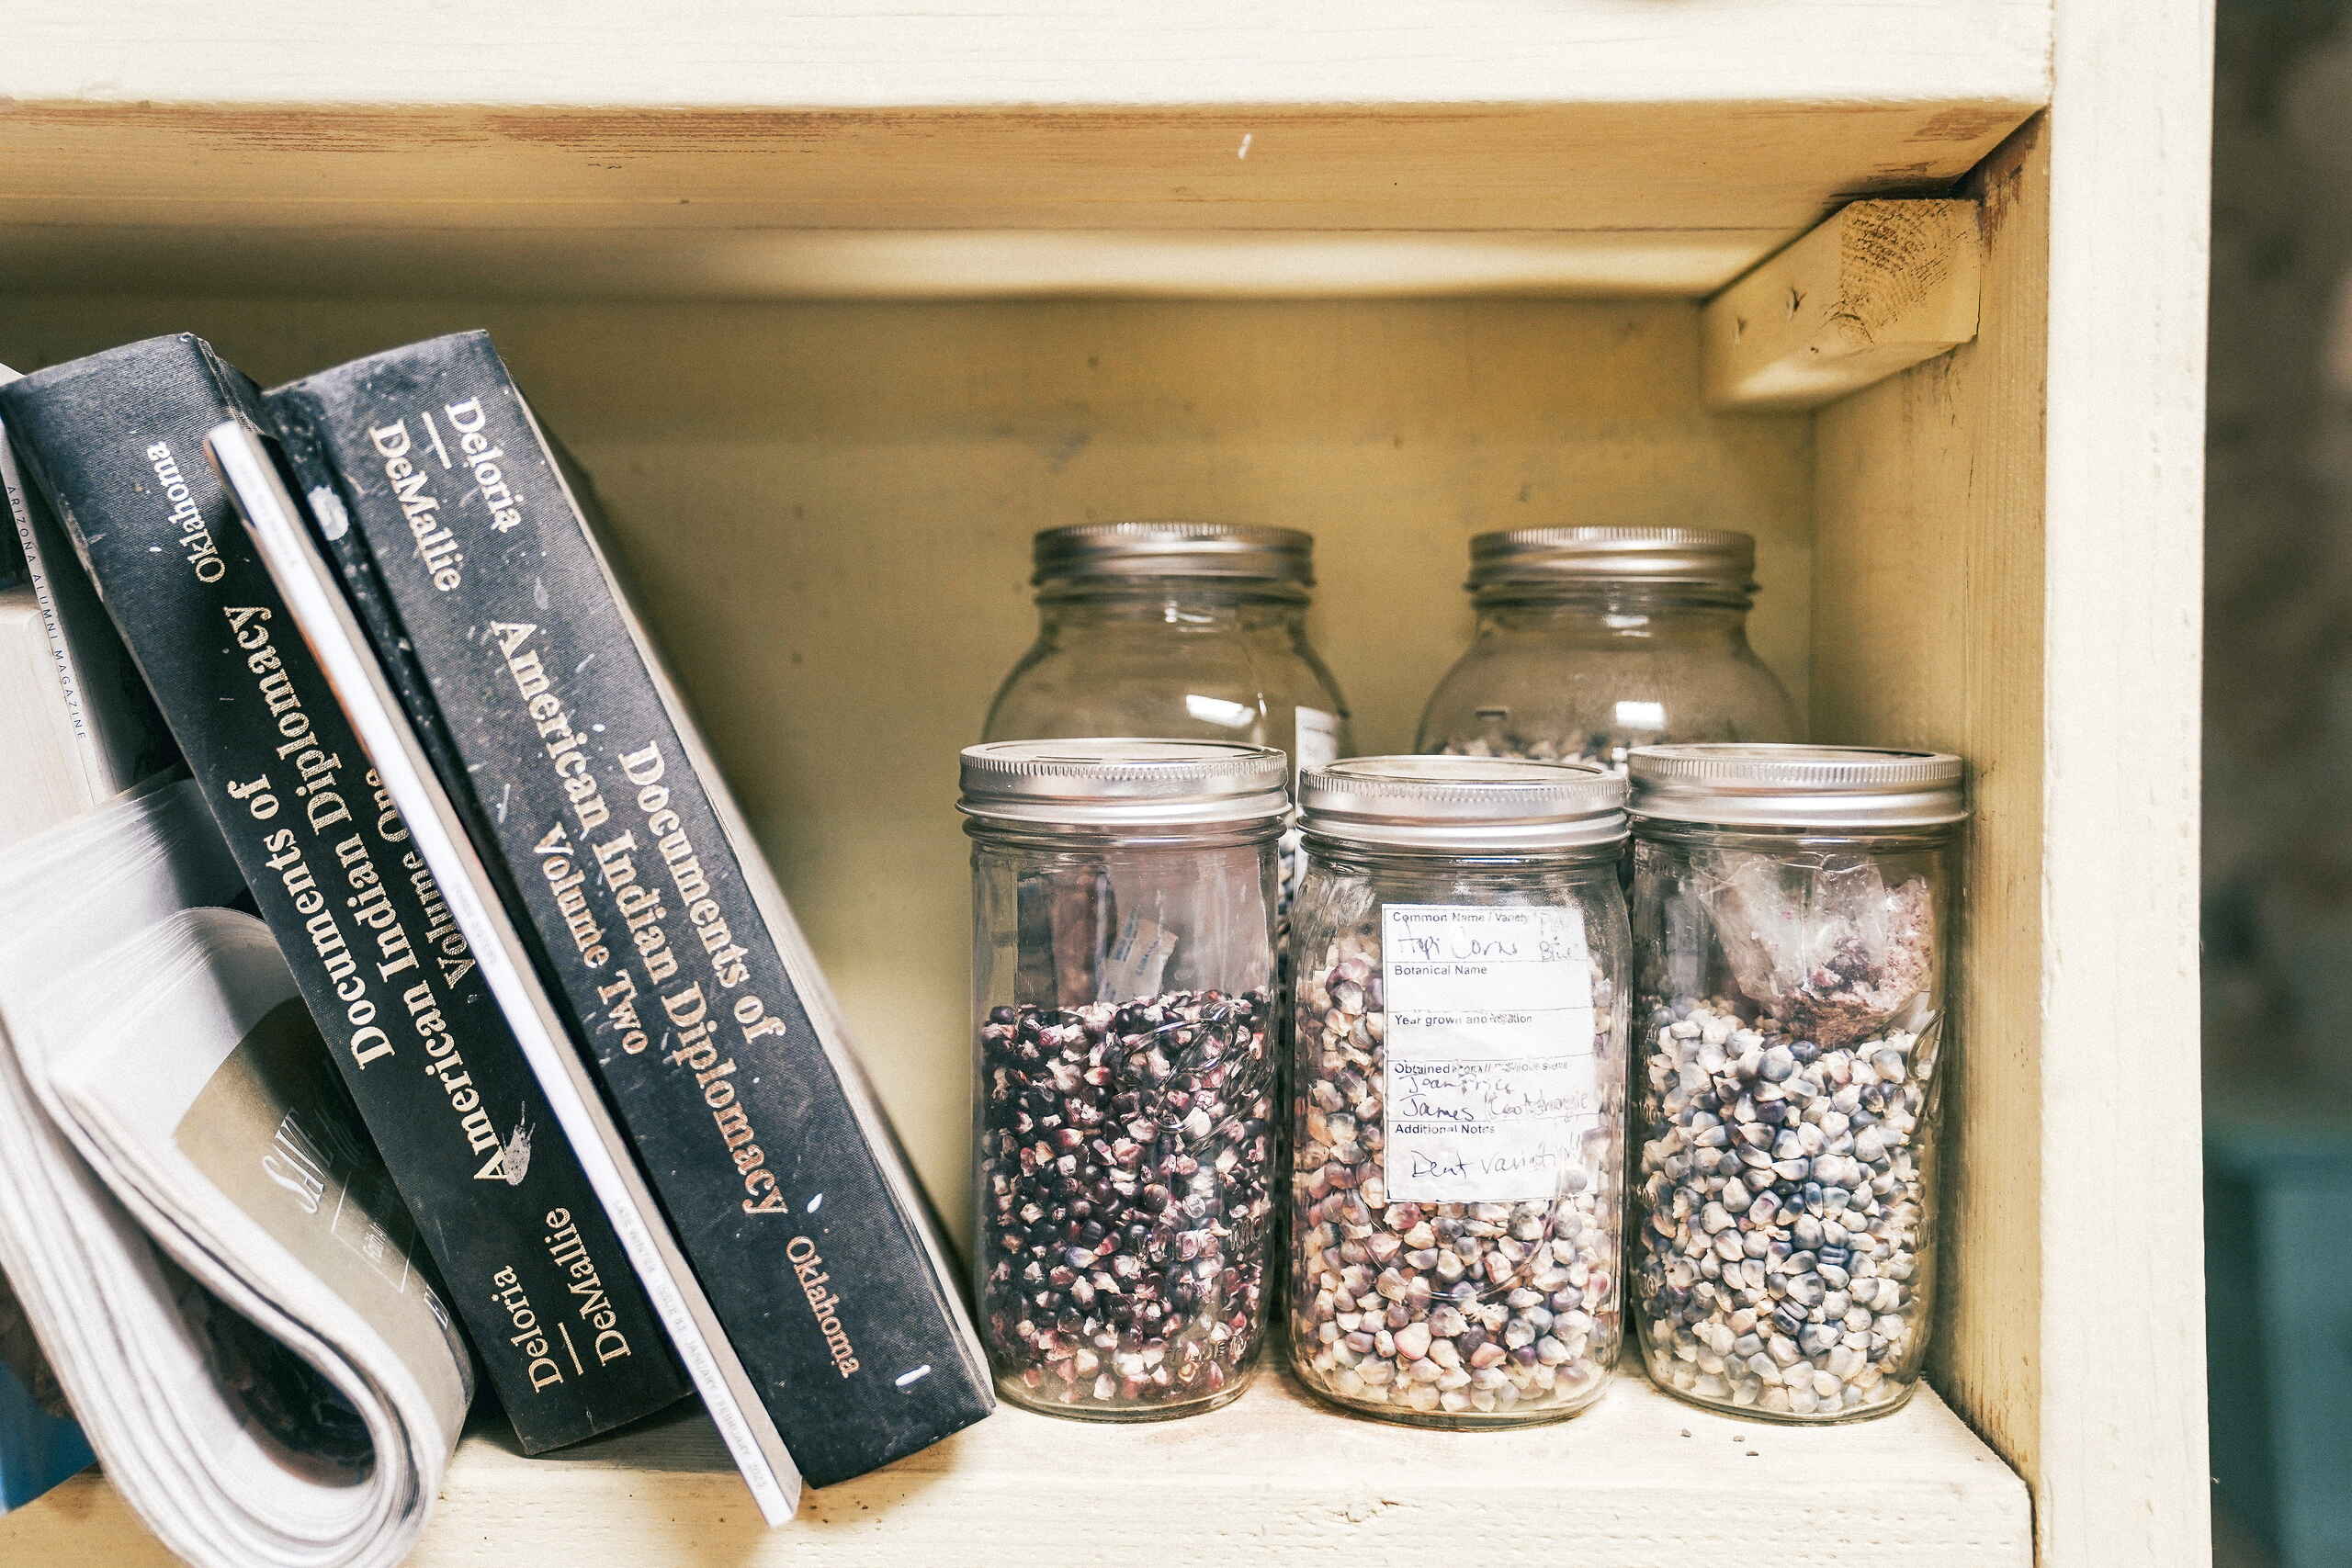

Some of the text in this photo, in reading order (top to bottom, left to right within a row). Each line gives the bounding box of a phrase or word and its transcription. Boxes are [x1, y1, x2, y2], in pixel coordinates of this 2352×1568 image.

[146, 440, 226, 584] Oklahoma
[368, 419, 461, 592] DeMallie
[445, 397, 522, 533] Deloria
[7, 484, 86, 740] ARIZONA ALUMNI MAGAZINE
[222, 605, 352, 836] Diplomacy
[366, 768, 410, 843] One
[227, 774, 396, 1070] Documents of
[335, 833, 420, 984] Indian
[402, 852, 476, 990] Volume
[490, 620, 788, 1215] American Indian Diplomacy
[534, 820, 647, 1056] Volume Two
[618, 740, 785, 1044] Documents of
[1393, 911, 1448, 923] Common
[1453, 911, 1485, 923] Name
[1395, 964, 1487, 976] Botanical Name
[1395, 1014, 1421, 1026] Year
[402, 979, 509, 1181] American
[1395, 1063, 1451, 1075] Obtained
[1395, 1123, 1497, 1134] Additional Notes
[1399, 1093, 1474, 1122] James
[1410, 1149, 1471, 1183] Dent
[492, 1265, 563, 1394] Deloria
[546, 1206, 632, 1367] DeMallie
[786, 1235, 861, 1379] Oklahoma
